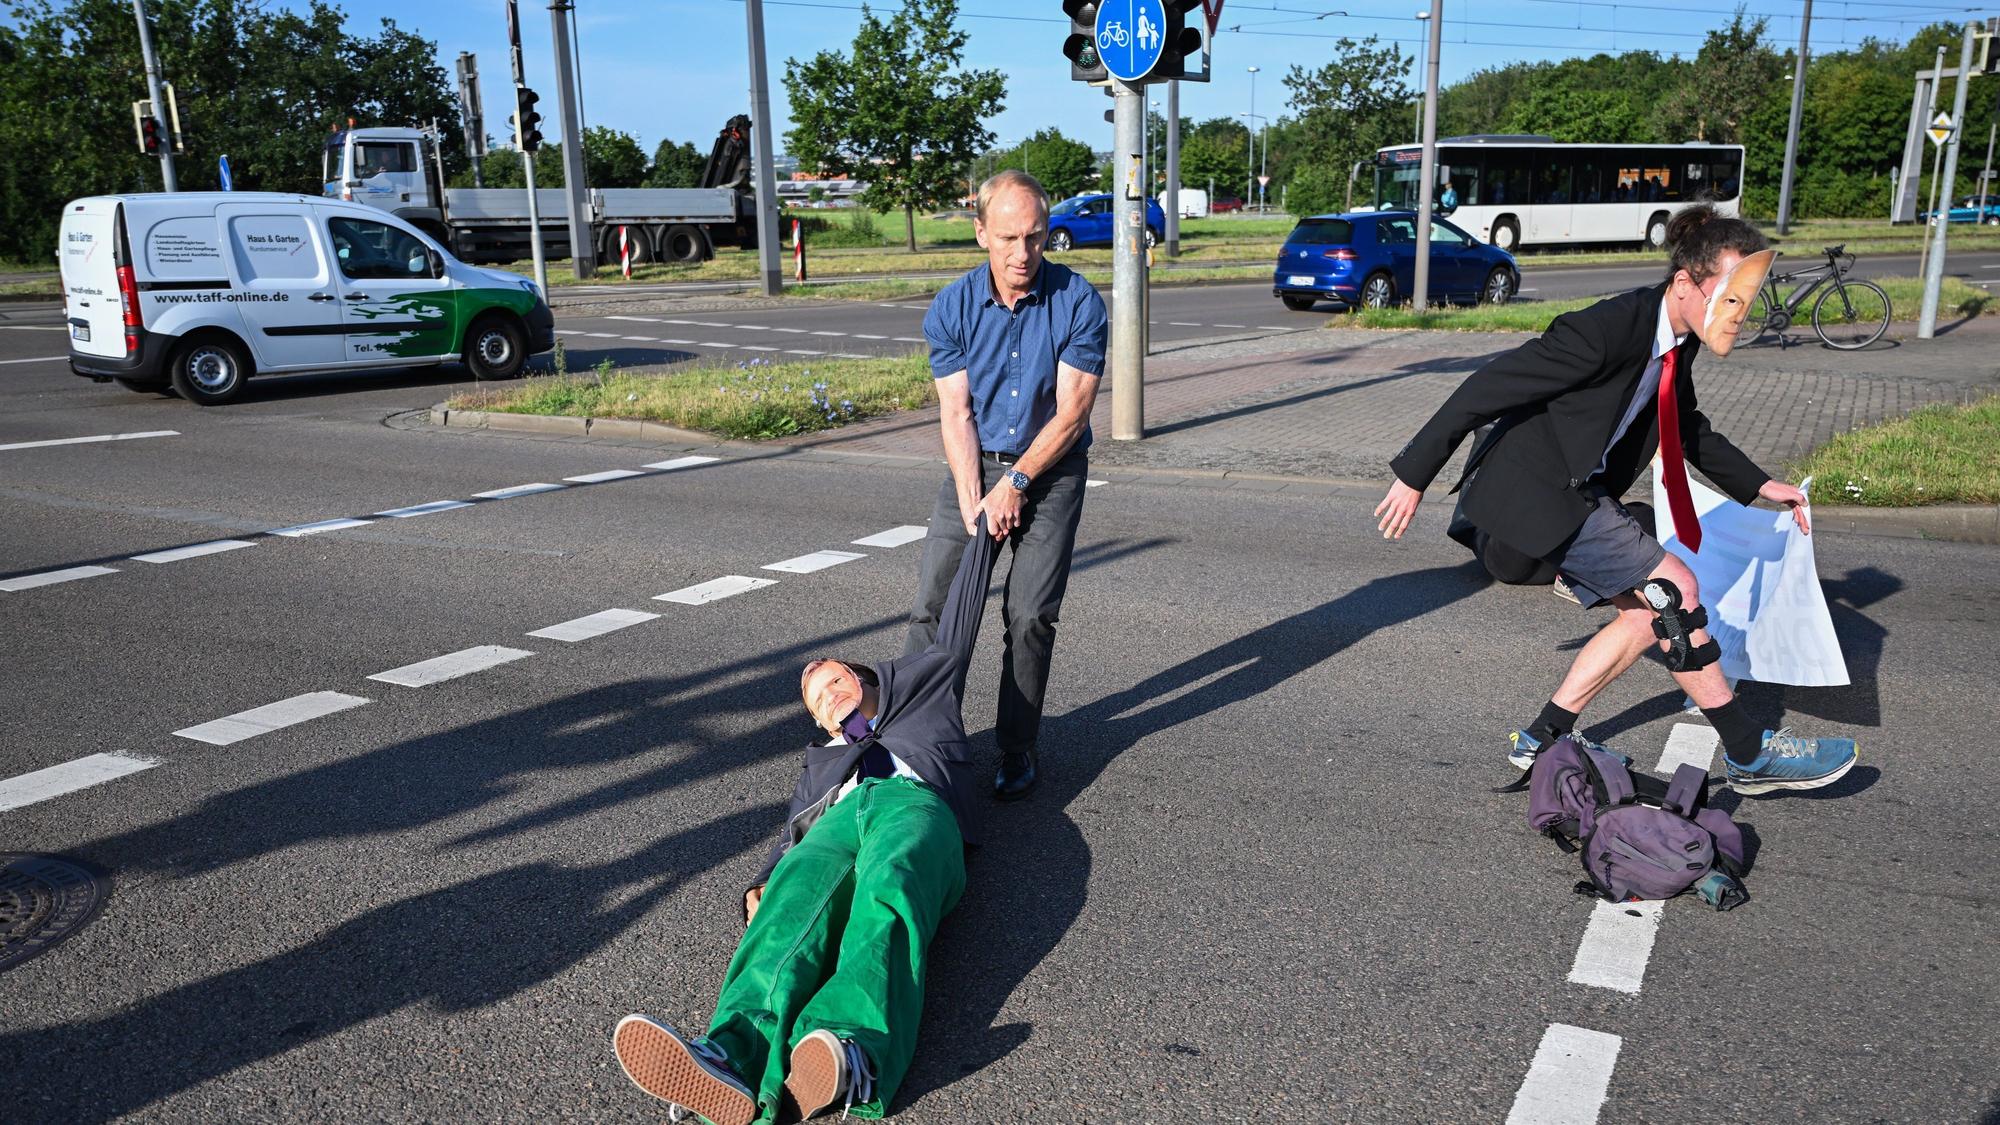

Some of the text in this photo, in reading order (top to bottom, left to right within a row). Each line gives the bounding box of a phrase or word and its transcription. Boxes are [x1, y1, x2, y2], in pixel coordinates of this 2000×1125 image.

[247, 234, 300, 243] Haus & Garten
[154, 291, 289, 303] www.taff-online.de
[354, 344, 373, 353] Tel.
